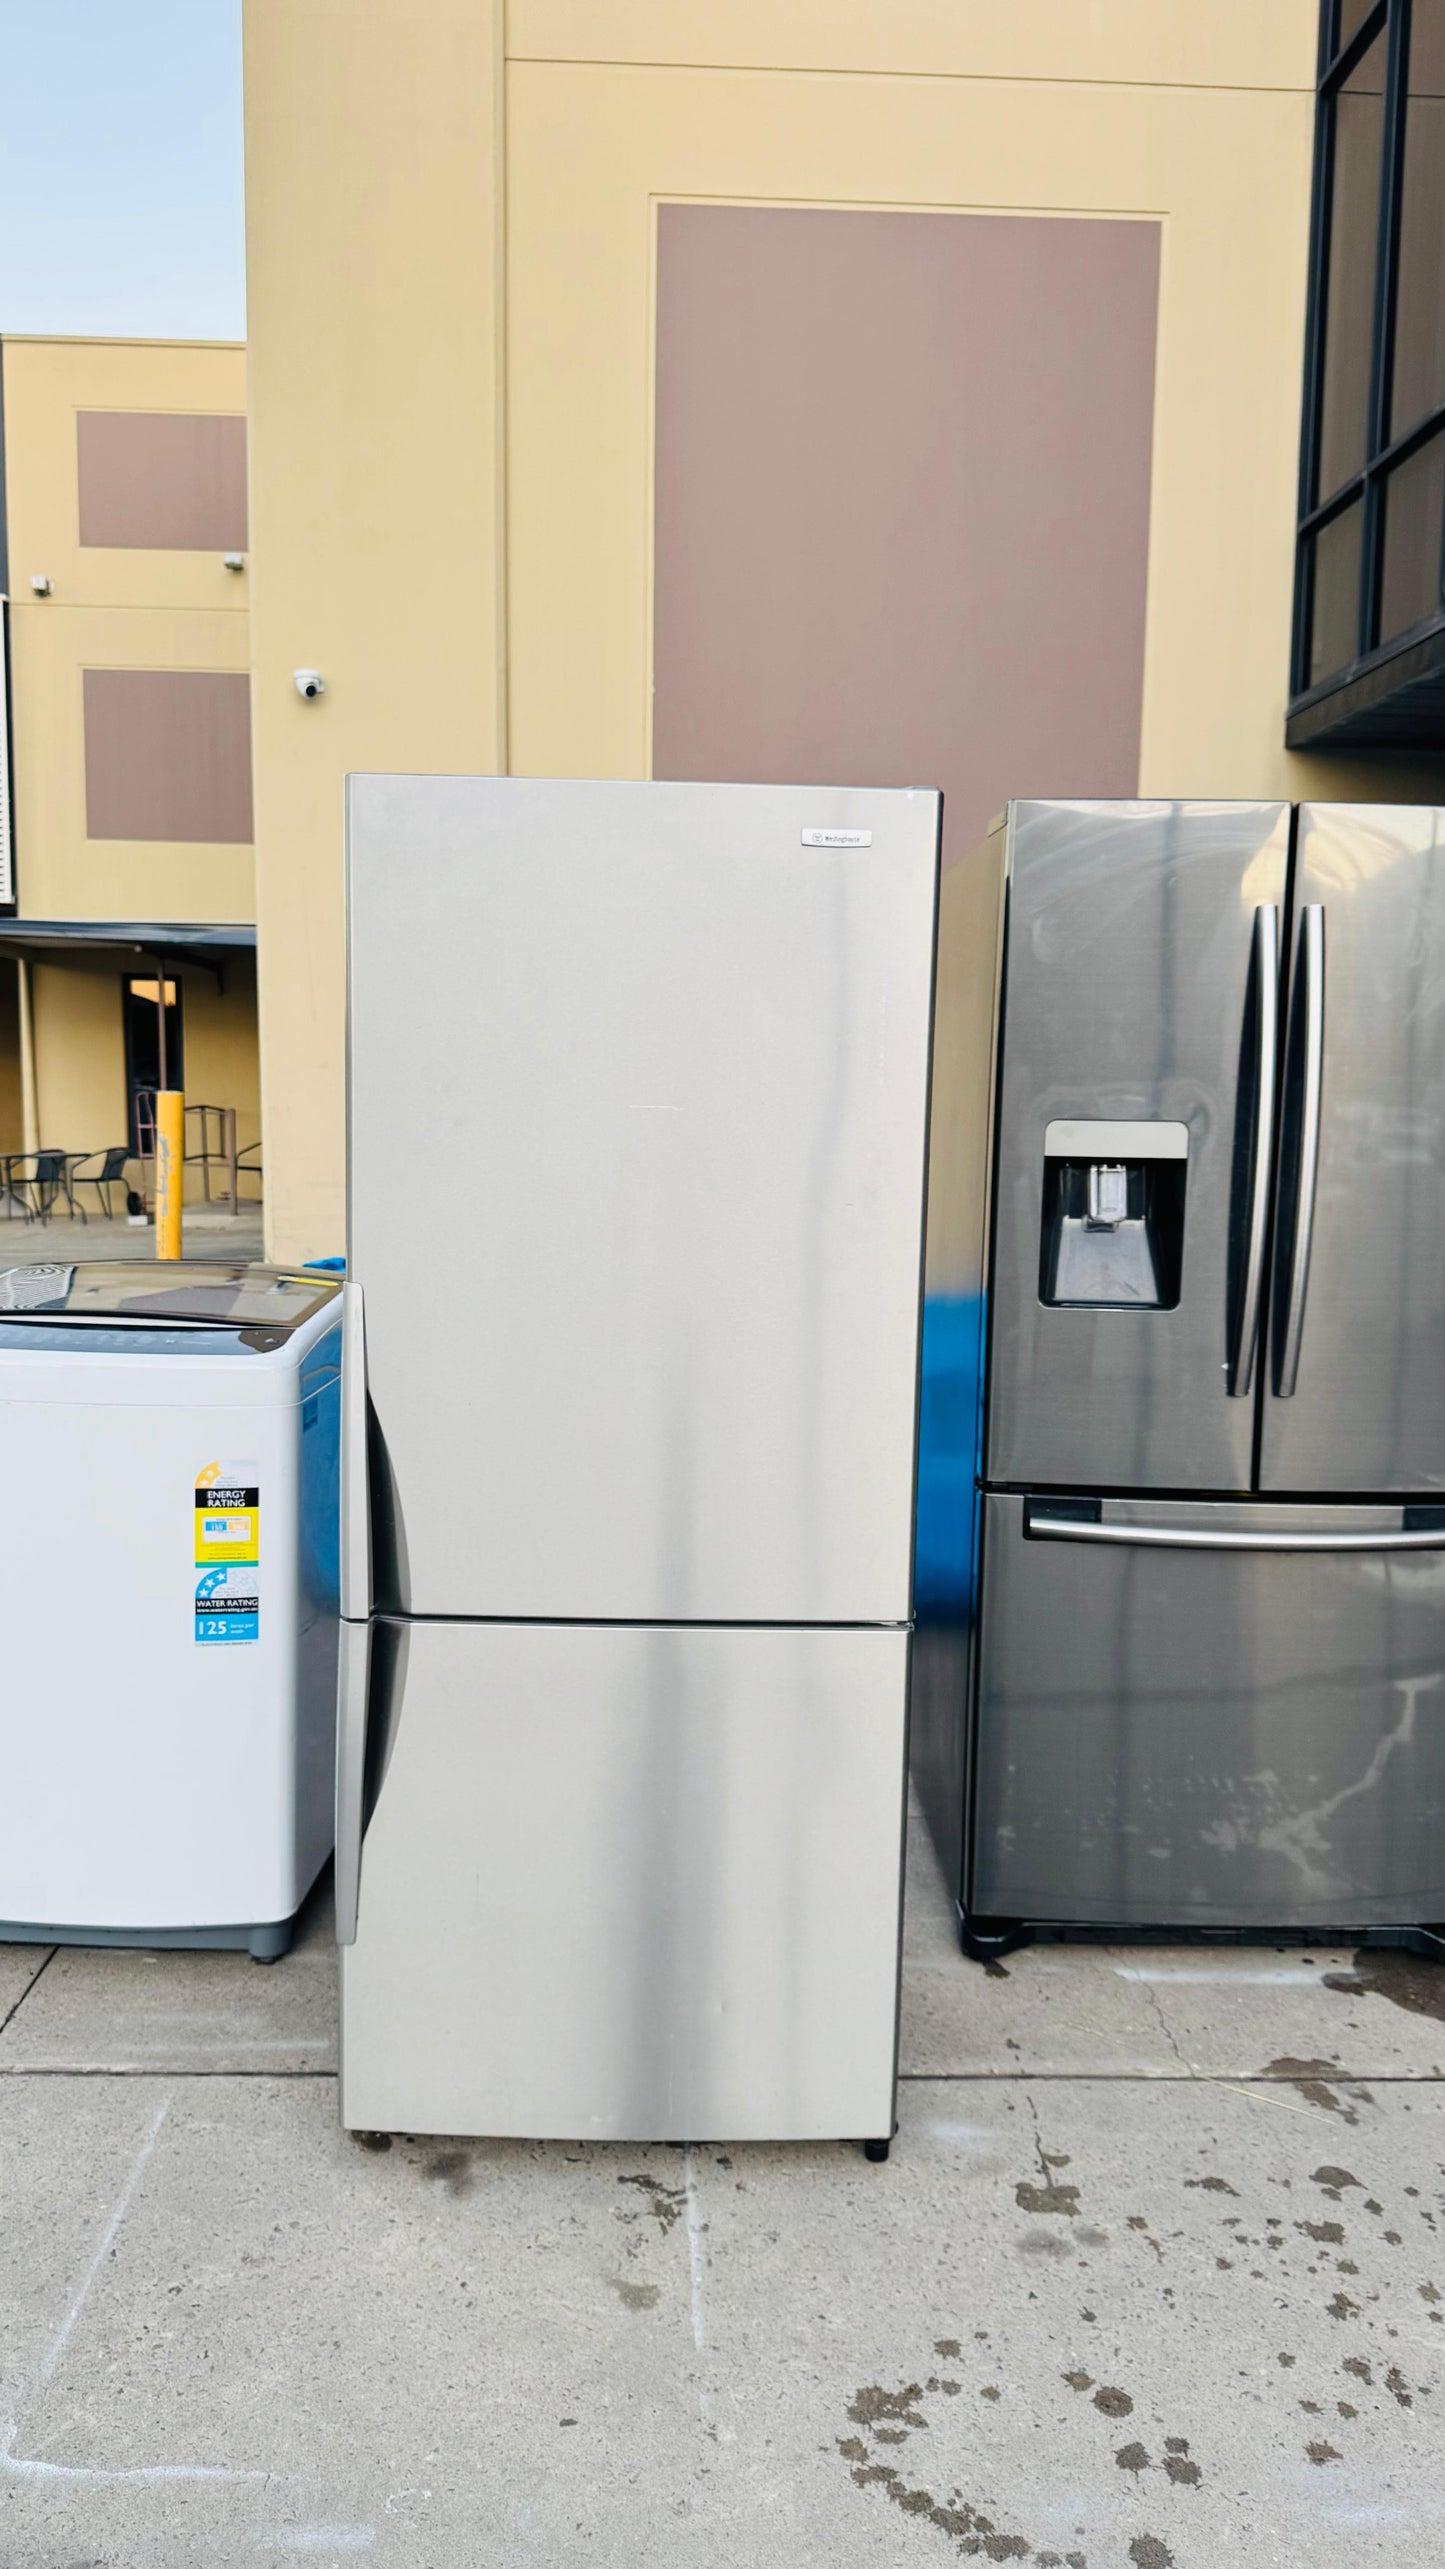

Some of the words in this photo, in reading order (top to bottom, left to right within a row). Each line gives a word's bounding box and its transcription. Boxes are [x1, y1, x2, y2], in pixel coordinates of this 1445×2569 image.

[207, 1490, 246, 1499] ENERGY
[207, 1499, 246, 1507] RATING
[196, 1600, 226, 1608] WATER
[227, 1599, 258, 1607] RATING
[199, 1621, 227, 1635] 125
